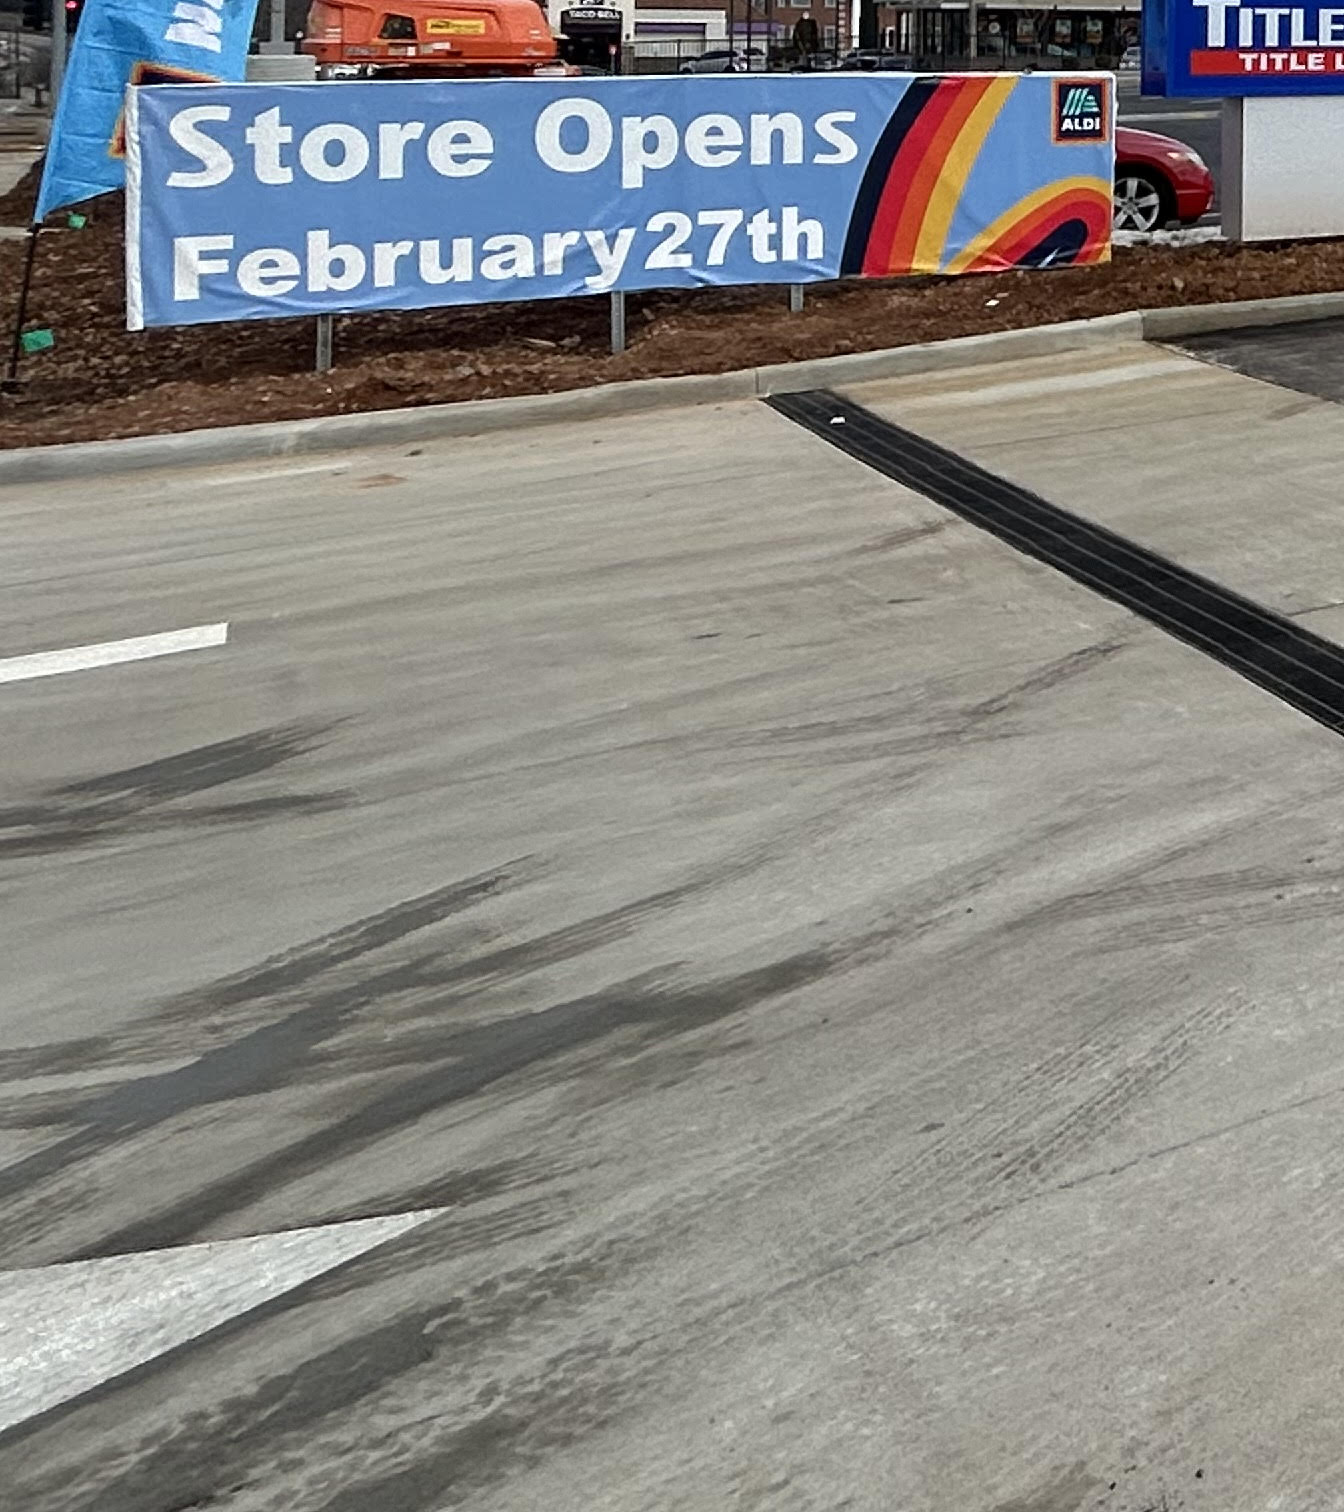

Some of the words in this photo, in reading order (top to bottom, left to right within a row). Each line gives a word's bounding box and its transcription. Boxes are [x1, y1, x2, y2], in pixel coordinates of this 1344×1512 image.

[1238, 52, 1325, 71] TITLE
[166, 97, 495, 188] Store
[535, 97, 858, 189] Opens
[1061, 117, 1101, 131] ALDI
[173, 228, 637, 302] February
[644, 205, 824, 270] 27th
